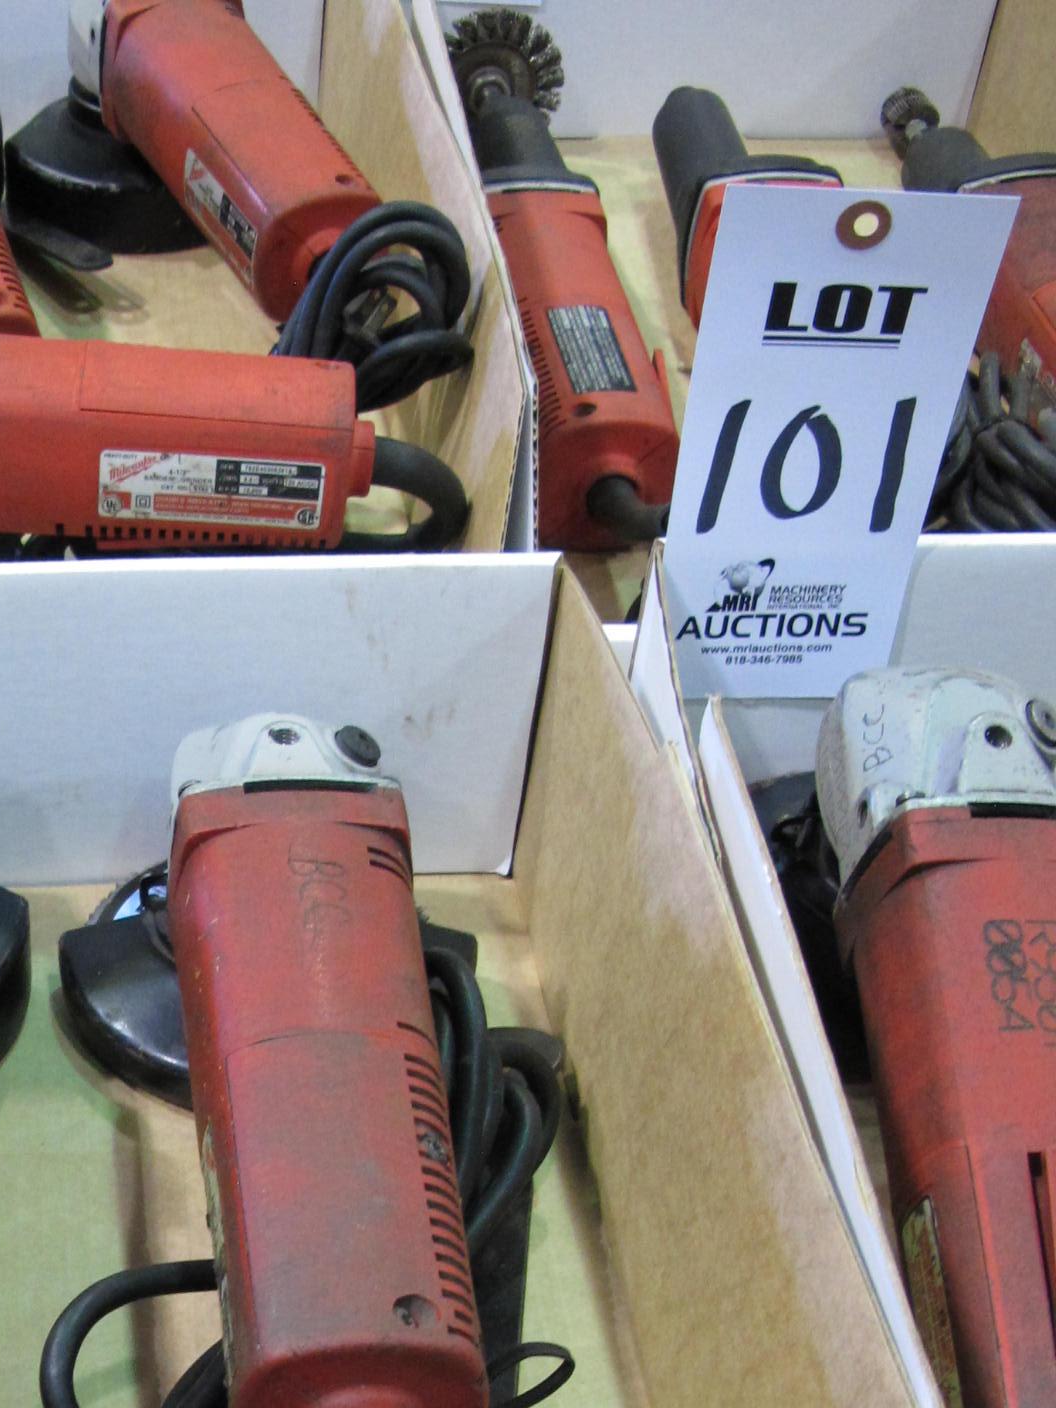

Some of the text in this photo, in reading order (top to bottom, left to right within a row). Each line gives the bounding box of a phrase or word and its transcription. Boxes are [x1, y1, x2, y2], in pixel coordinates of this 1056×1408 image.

[764, 282, 929, 335] LOT
[696, 397, 917, 534] 101
[768, 595, 844, 604] RESOURCES
[770, 584, 847, 595] MACHINERY
[721, 593, 760, 613] MRI
[675, 613, 869, 640] AUCTIONS
[701, 643, 832, 655] www.mriauctions.com
